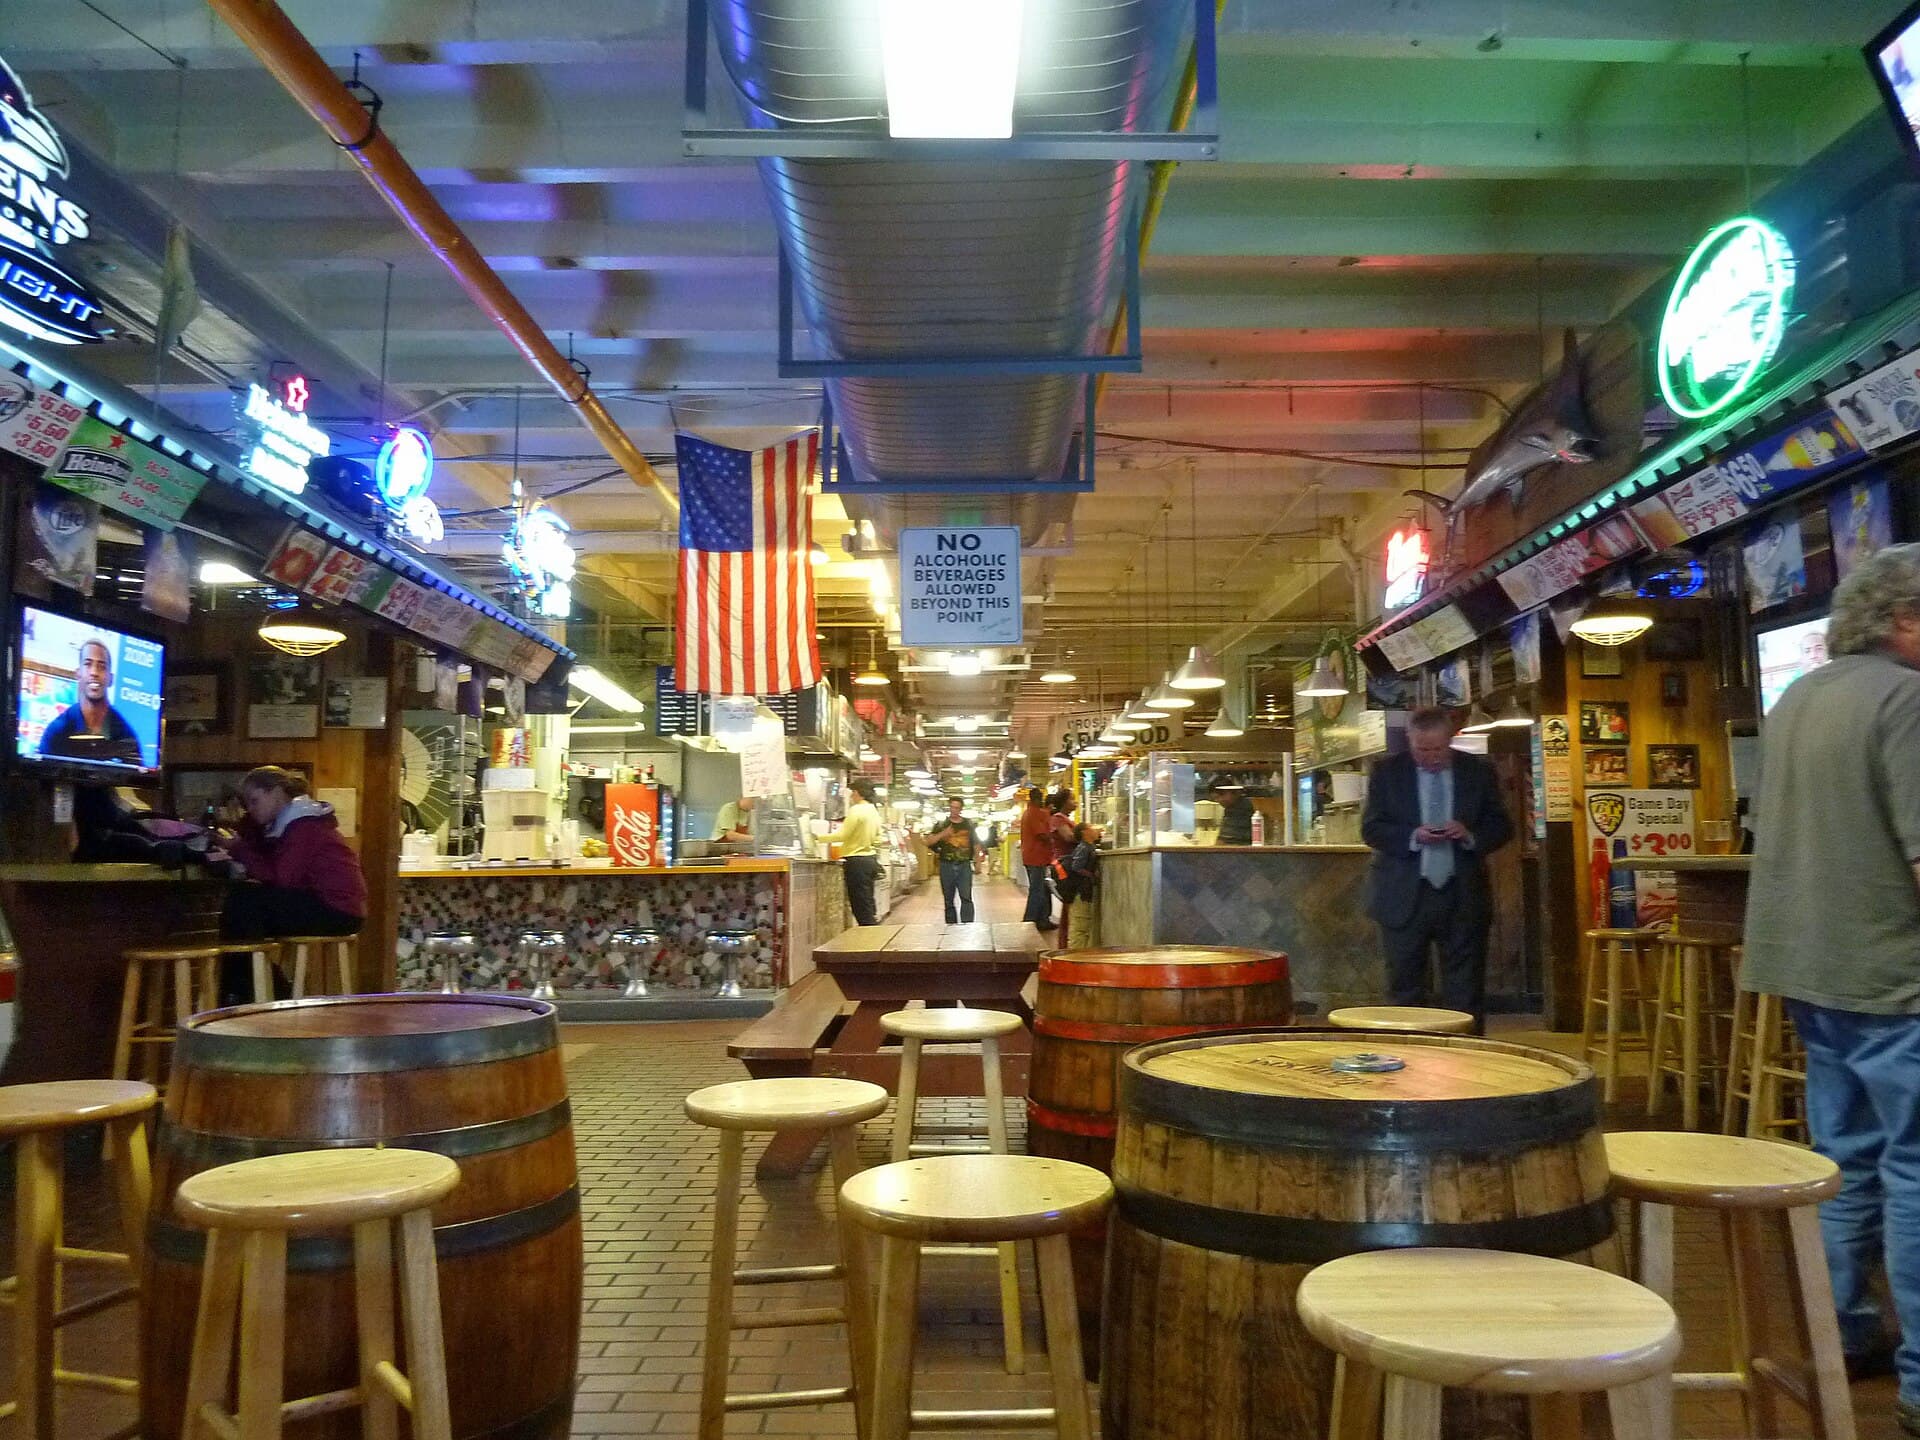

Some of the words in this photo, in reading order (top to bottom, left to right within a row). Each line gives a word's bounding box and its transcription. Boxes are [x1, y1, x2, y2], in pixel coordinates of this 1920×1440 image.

[937, 533, 982, 551] NO
[913, 554, 1007, 567] ALCOHOLIC
[914, 569, 1006, 582] BEVERAGES
[925, 584, 996, 595] ALLOWED
[910, 598, 972, 610] BEYOND
[975, 597, 1010, 609] THIS
[936, 611, 985, 623] POINT
[1628, 797, 1663, 810] Game
[1666, 797, 1691, 813] Day
[1637, 812, 1684, 827] Special
[613, 802, 652, 867] Cola
